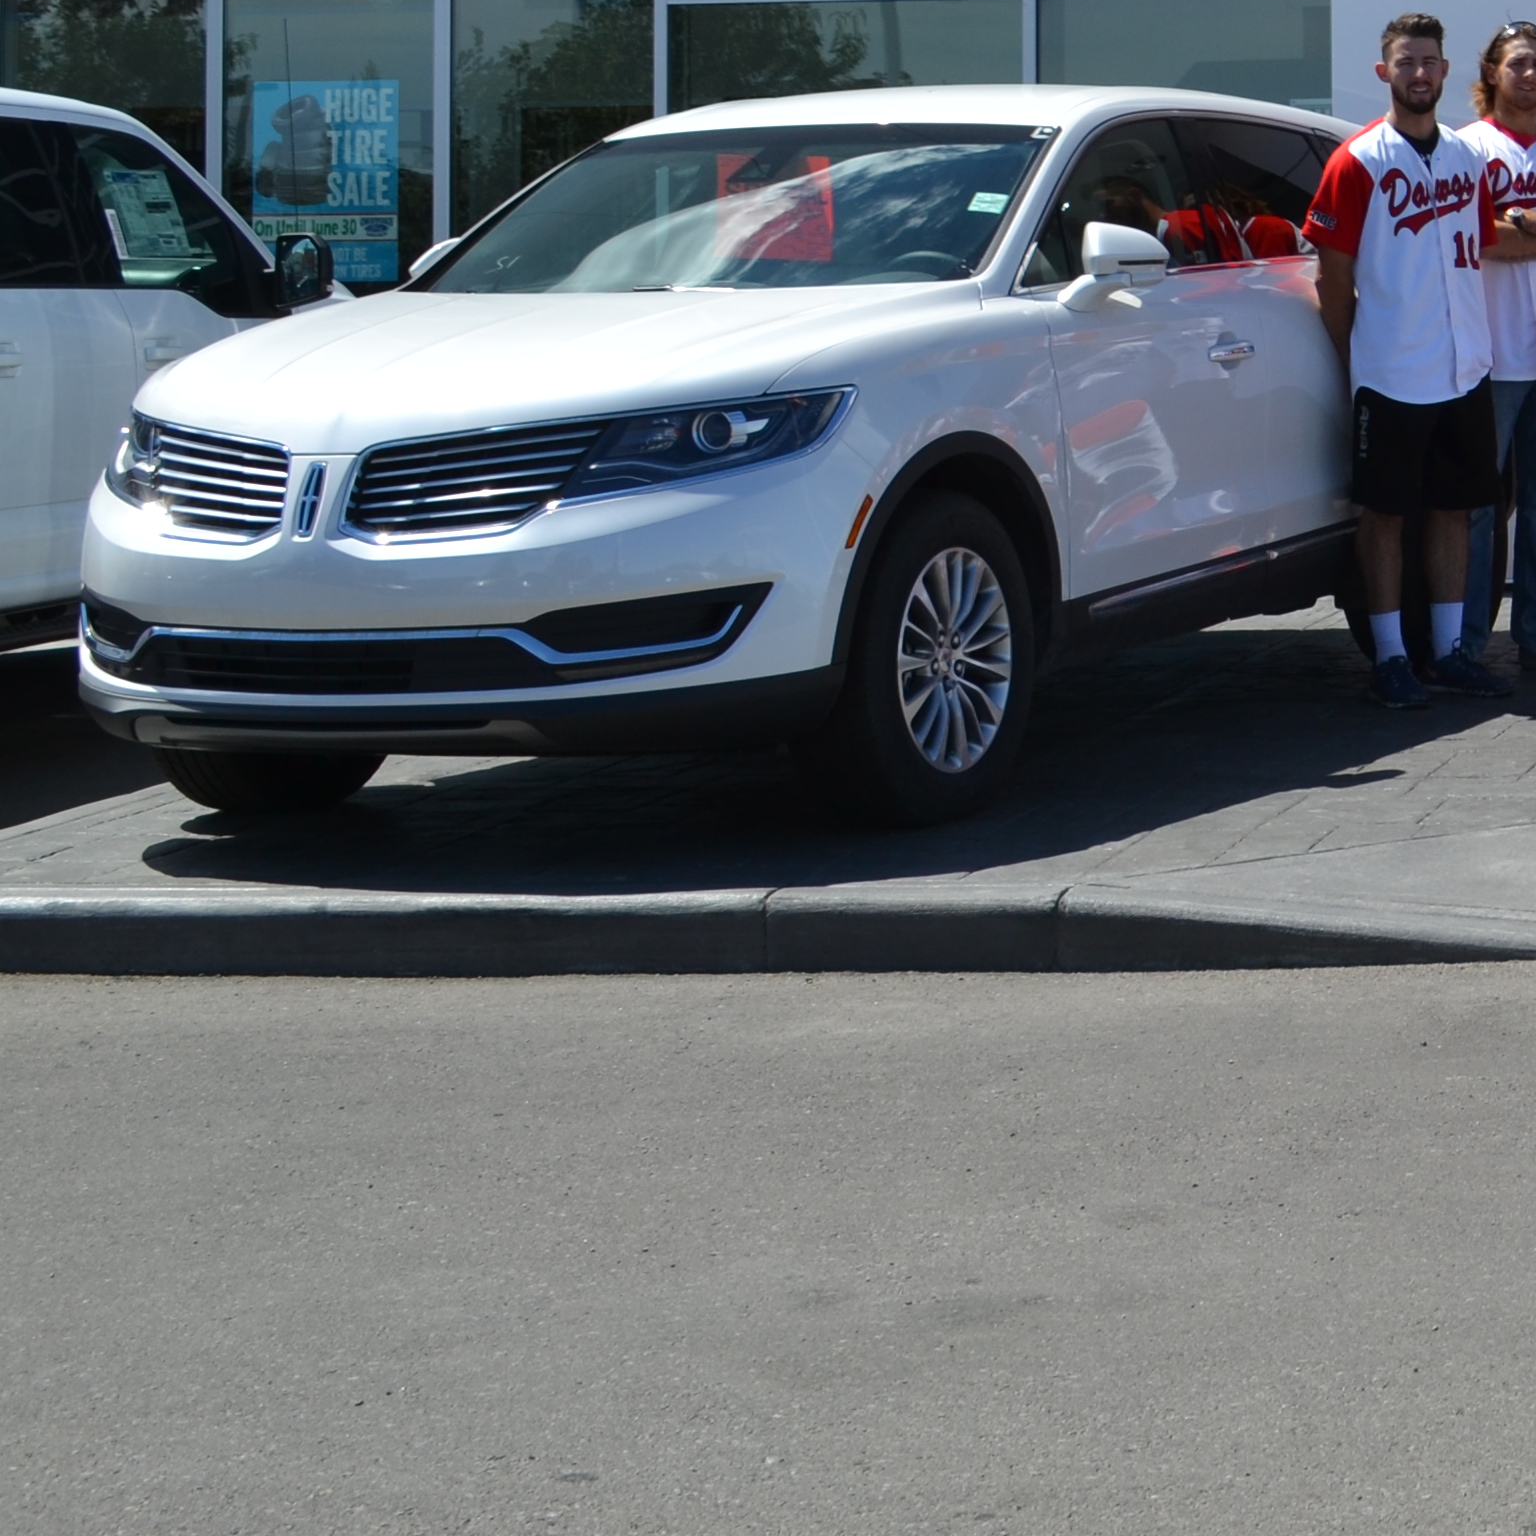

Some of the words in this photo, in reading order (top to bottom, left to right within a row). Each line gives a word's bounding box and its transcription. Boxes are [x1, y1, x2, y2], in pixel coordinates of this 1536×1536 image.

[324, 88, 394, 123] HUGE
[327, 129, 388, 165] TIRE
[327, 170, 391, 207] SALE
[1380, 168, 1475, 221] Dawgs
[255, 220, 273, 236] On
[341, 219, 358, 235] 30
[350, 264, 381, 278] TIRES
